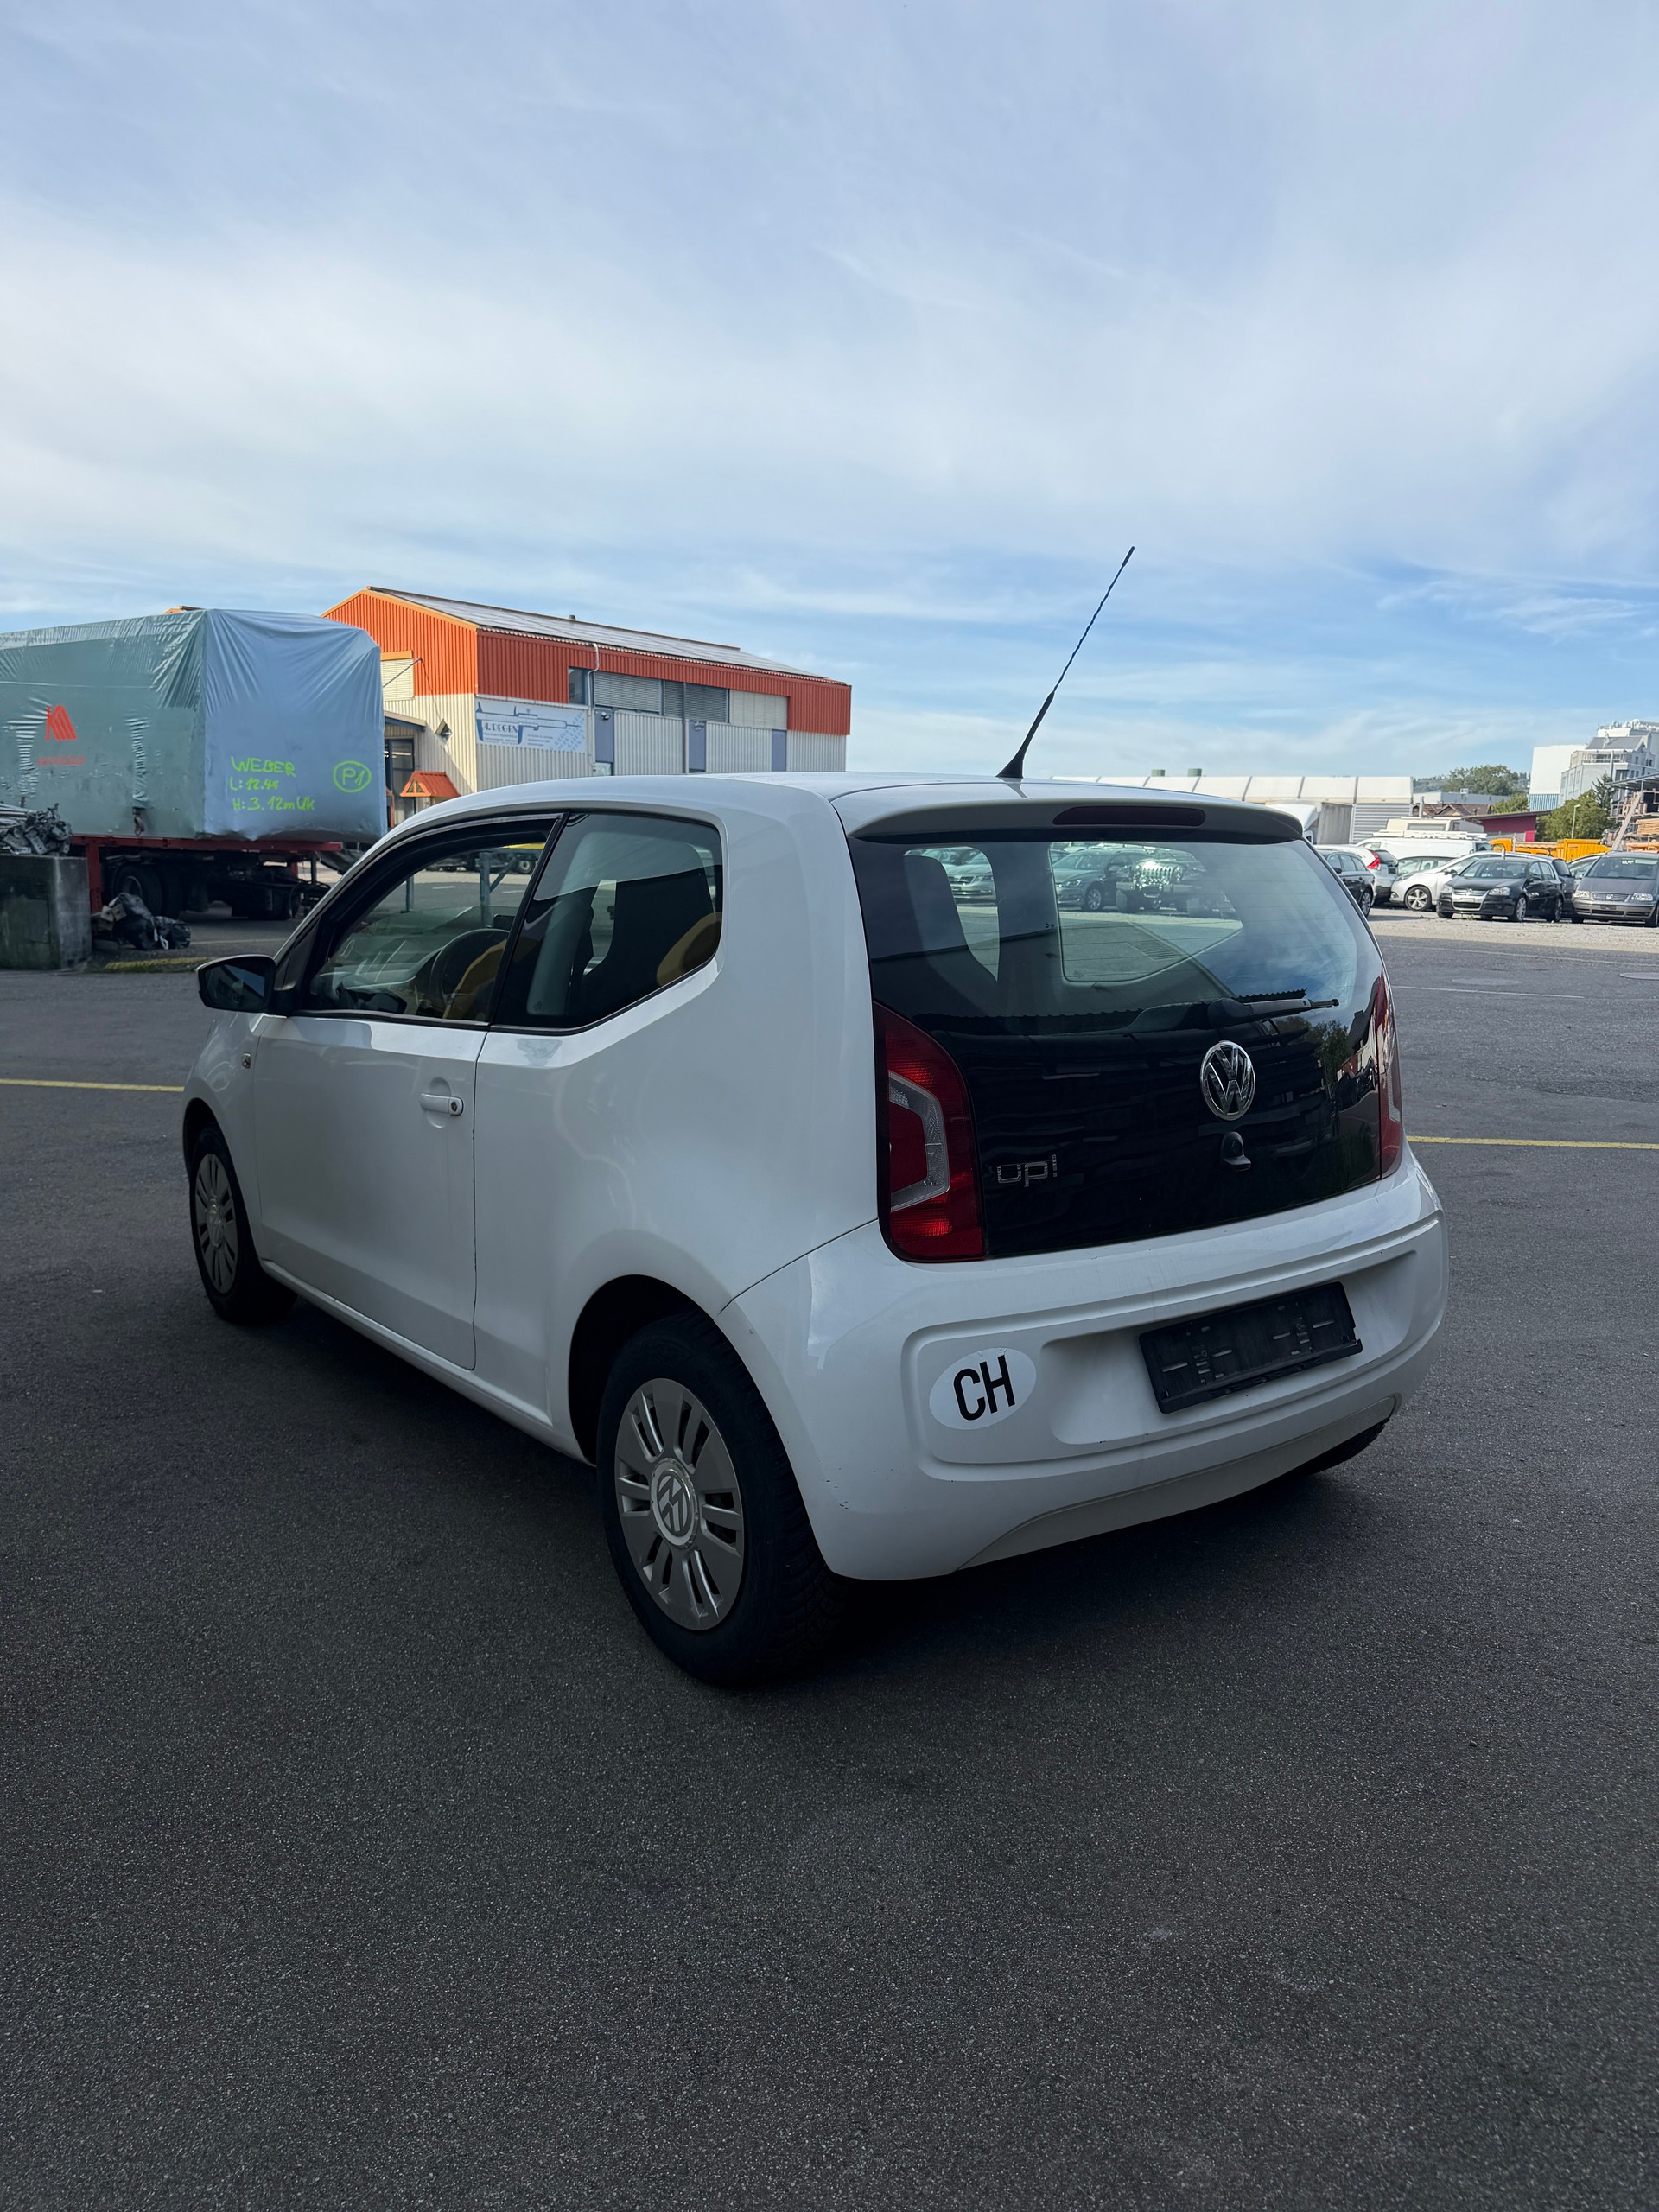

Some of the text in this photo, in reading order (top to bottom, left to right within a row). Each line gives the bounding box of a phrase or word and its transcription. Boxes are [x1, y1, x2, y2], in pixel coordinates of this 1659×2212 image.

[230, 755, 297, 778] WEBER
[342, 767, 366, 785] P1
[996, 1154, 1058, 1188] up!
[953, 1354, 1015, 1421] CH
